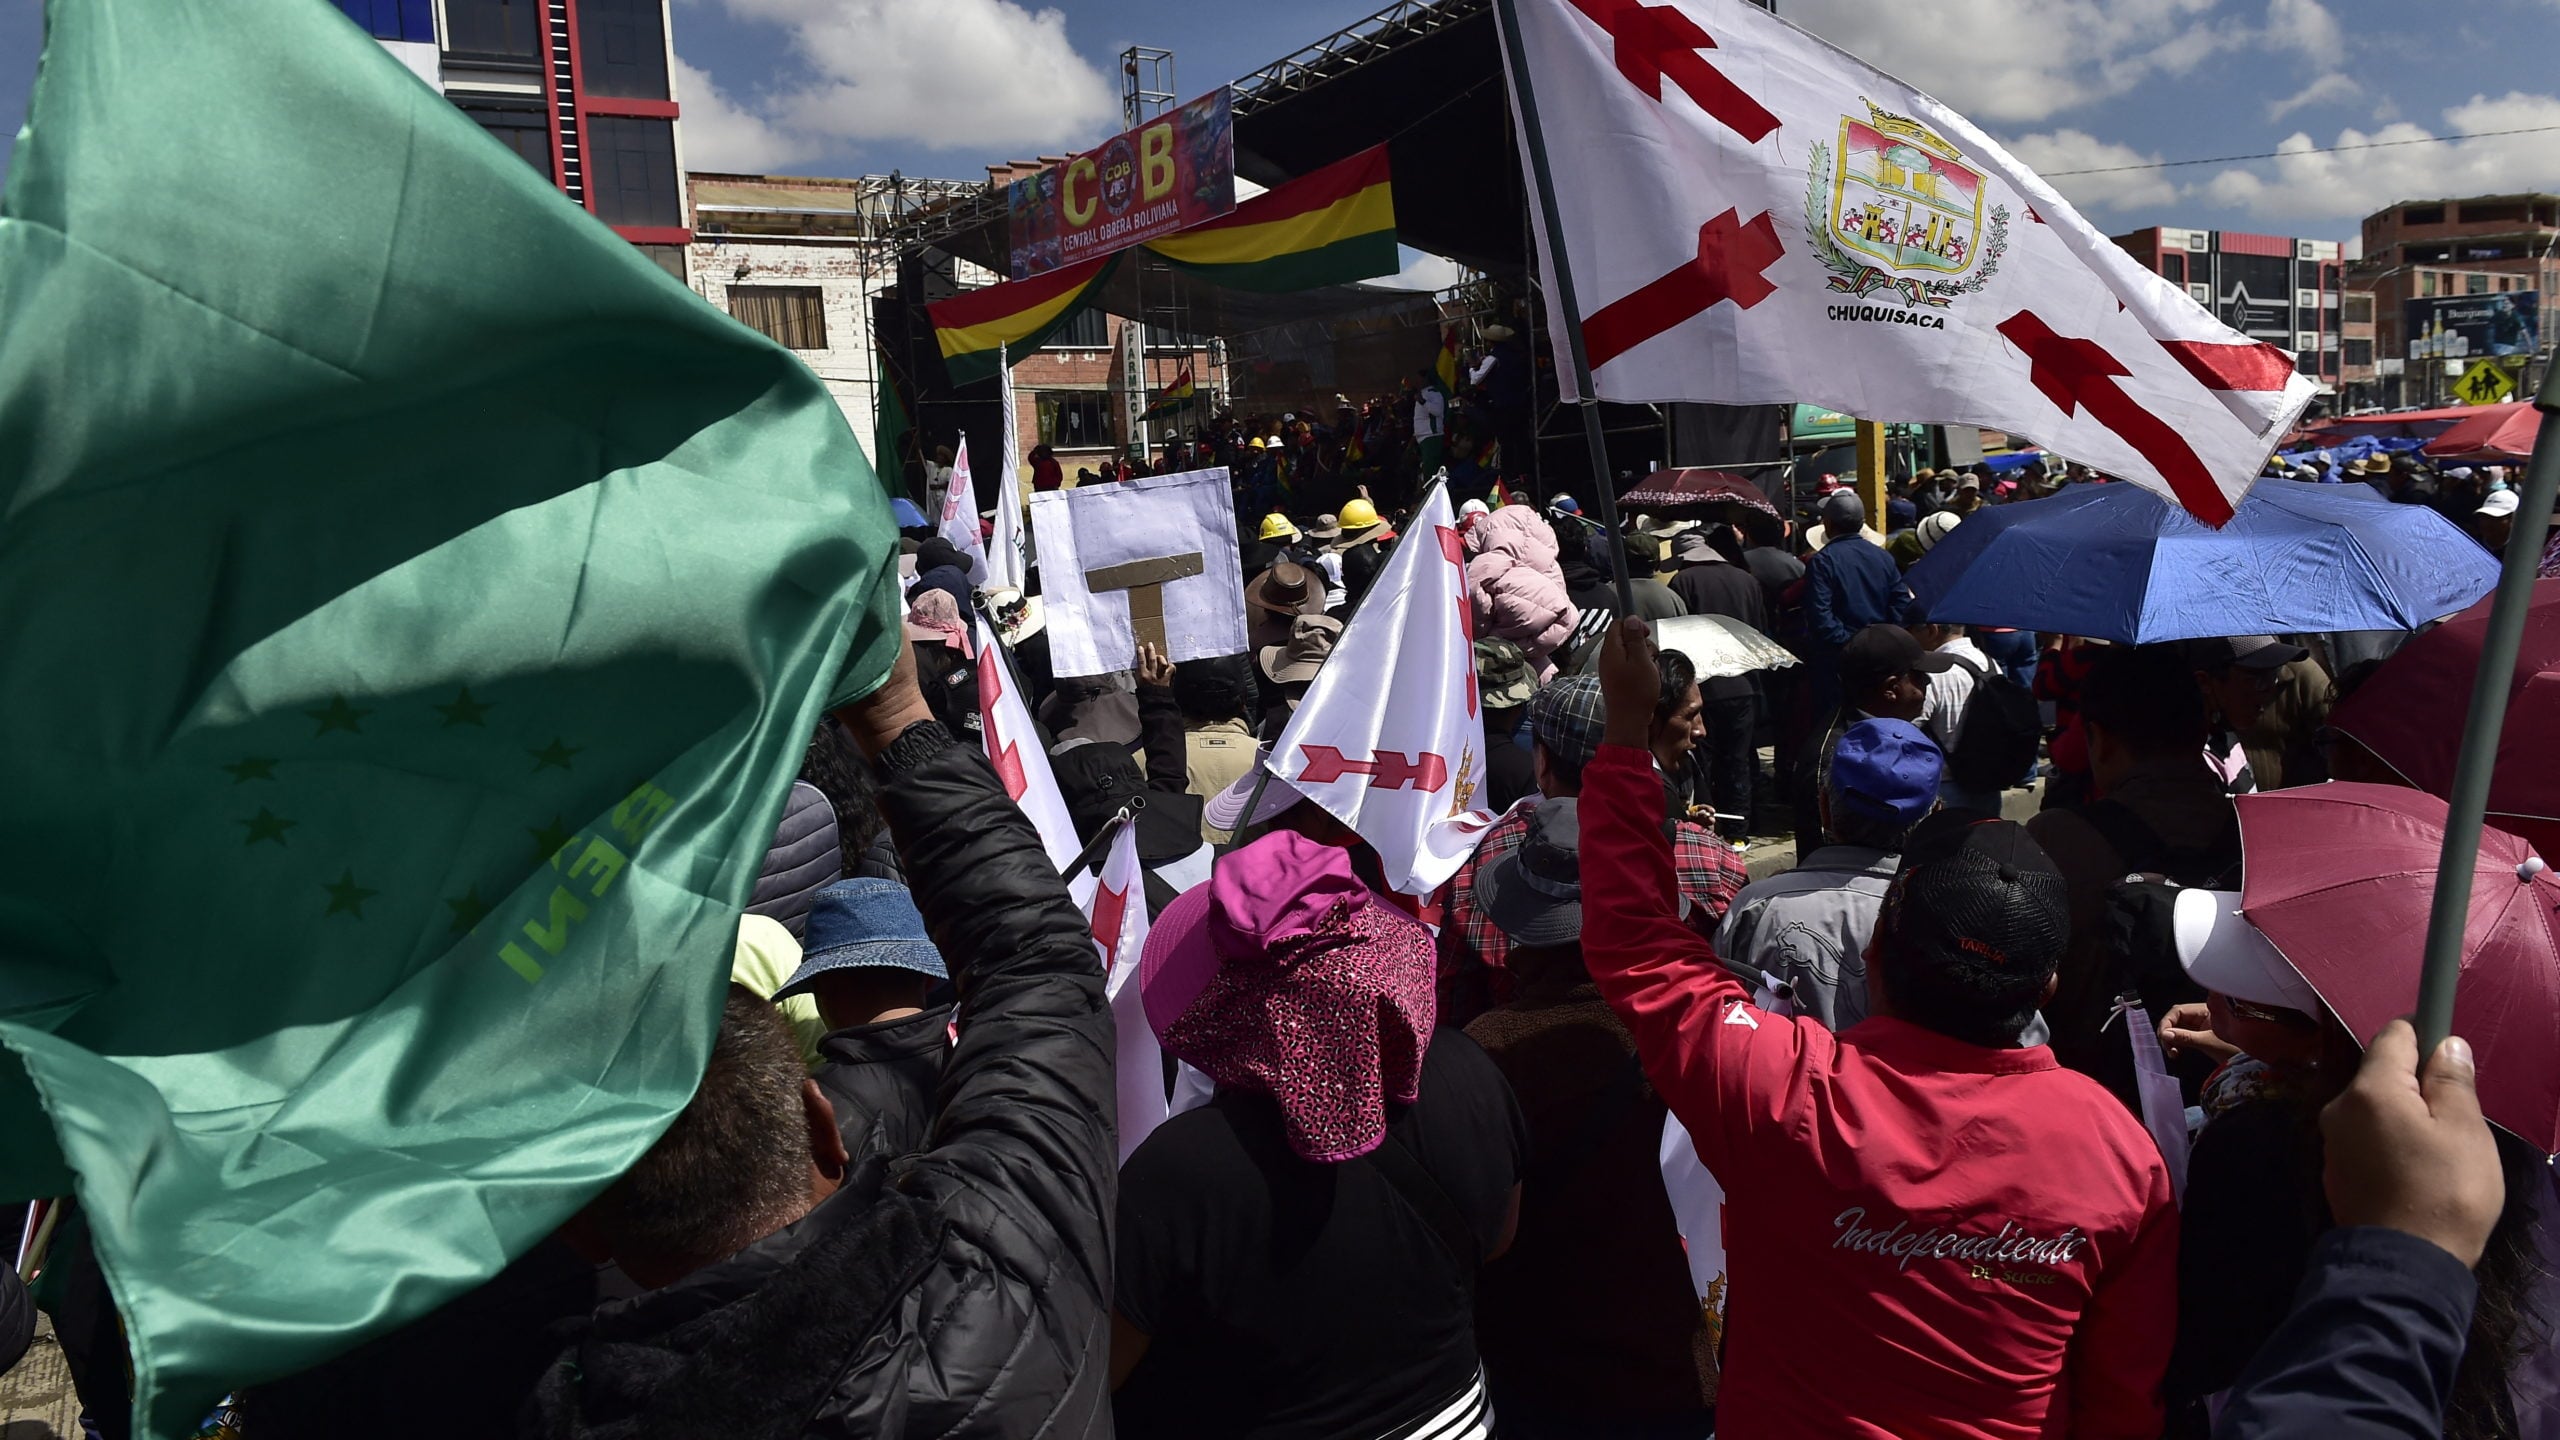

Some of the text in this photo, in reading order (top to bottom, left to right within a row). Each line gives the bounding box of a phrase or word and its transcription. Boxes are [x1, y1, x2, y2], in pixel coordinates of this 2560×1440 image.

[1104, 161, 1132, 183] COB
[1063, 228, 1099, 252] CENTRAL
[1100, 216, 1132, 241] OBRERA
[1134, 200, 1179, 230] BOLIVIANA
[1827, 305, 1945, 330] CHUQUISACA
[1126, 333, 1140, 443] FARMACIA
[1957, 936, 2009, 966] TARIJA
[1833, 1206, 2087, 1271] Independiente
[1971, 1265, 2058, 1285] DE SUCRE
